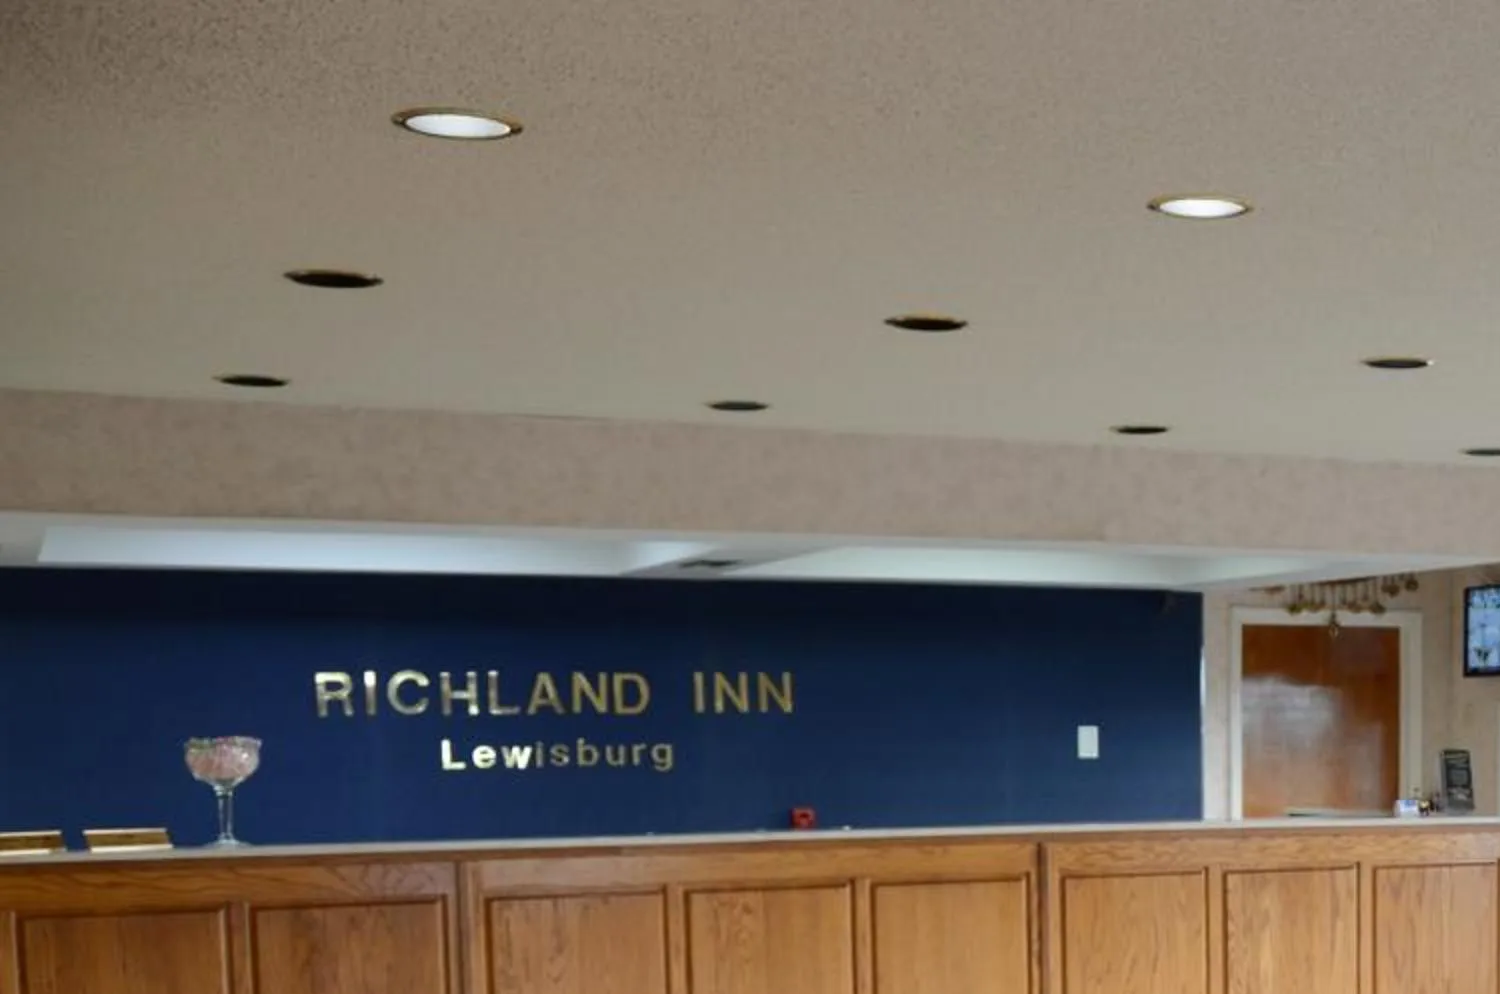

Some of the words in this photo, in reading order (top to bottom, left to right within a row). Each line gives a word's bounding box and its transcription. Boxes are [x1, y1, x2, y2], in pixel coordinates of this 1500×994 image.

[313, 669, 650, 716] RICHLAND
[692, 671, 795, 714] INN
[441, 738, 674, 771] Lewisburg
